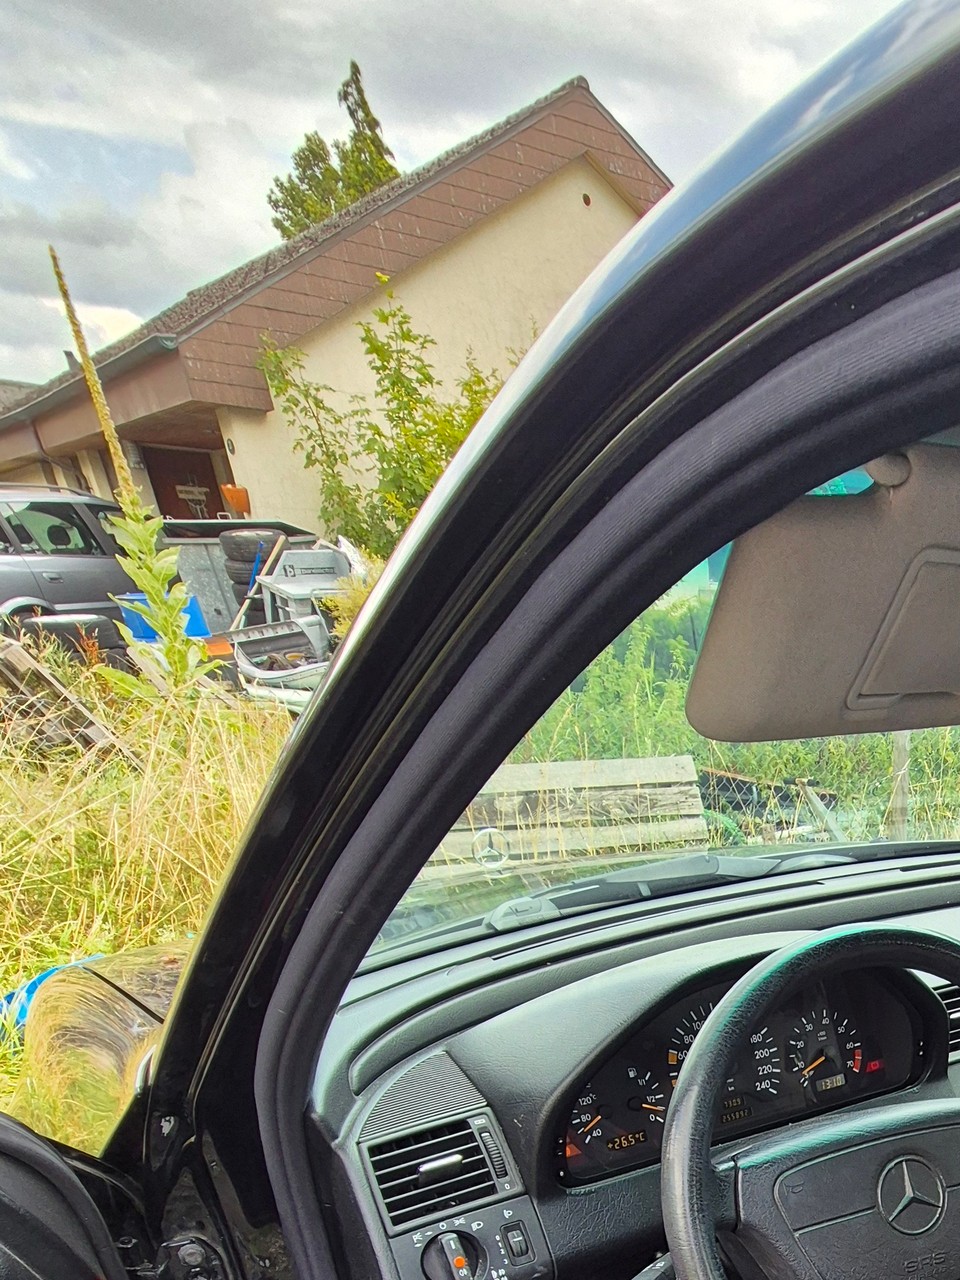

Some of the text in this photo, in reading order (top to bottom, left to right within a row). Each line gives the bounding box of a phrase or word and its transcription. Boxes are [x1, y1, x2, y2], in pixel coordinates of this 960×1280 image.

[805, 1024, 814, 1032] 30
[837, 1026, 846, 1034] 50
[683, 1034, 695, 1044] 80
[750, 1033, 763, 1044] 180
[797, 1040, 805, 1048] 20
[846, 1042, 855, 1050] 60
[754, 1048, 770, 1060] 200
[846, 1060, 854, 1068] 70
[757, 1064, 773, 1076] 220
[755, 1079, 771, 1091] 240
[822, 1077, 842, 1090] 13:10
[580, 1113, 592, 1122] 80
[649, 1113, 656, 1122] 0
[591, 1128, 602, 1137] 40
[902, 1251, 946, 1273] SRS
